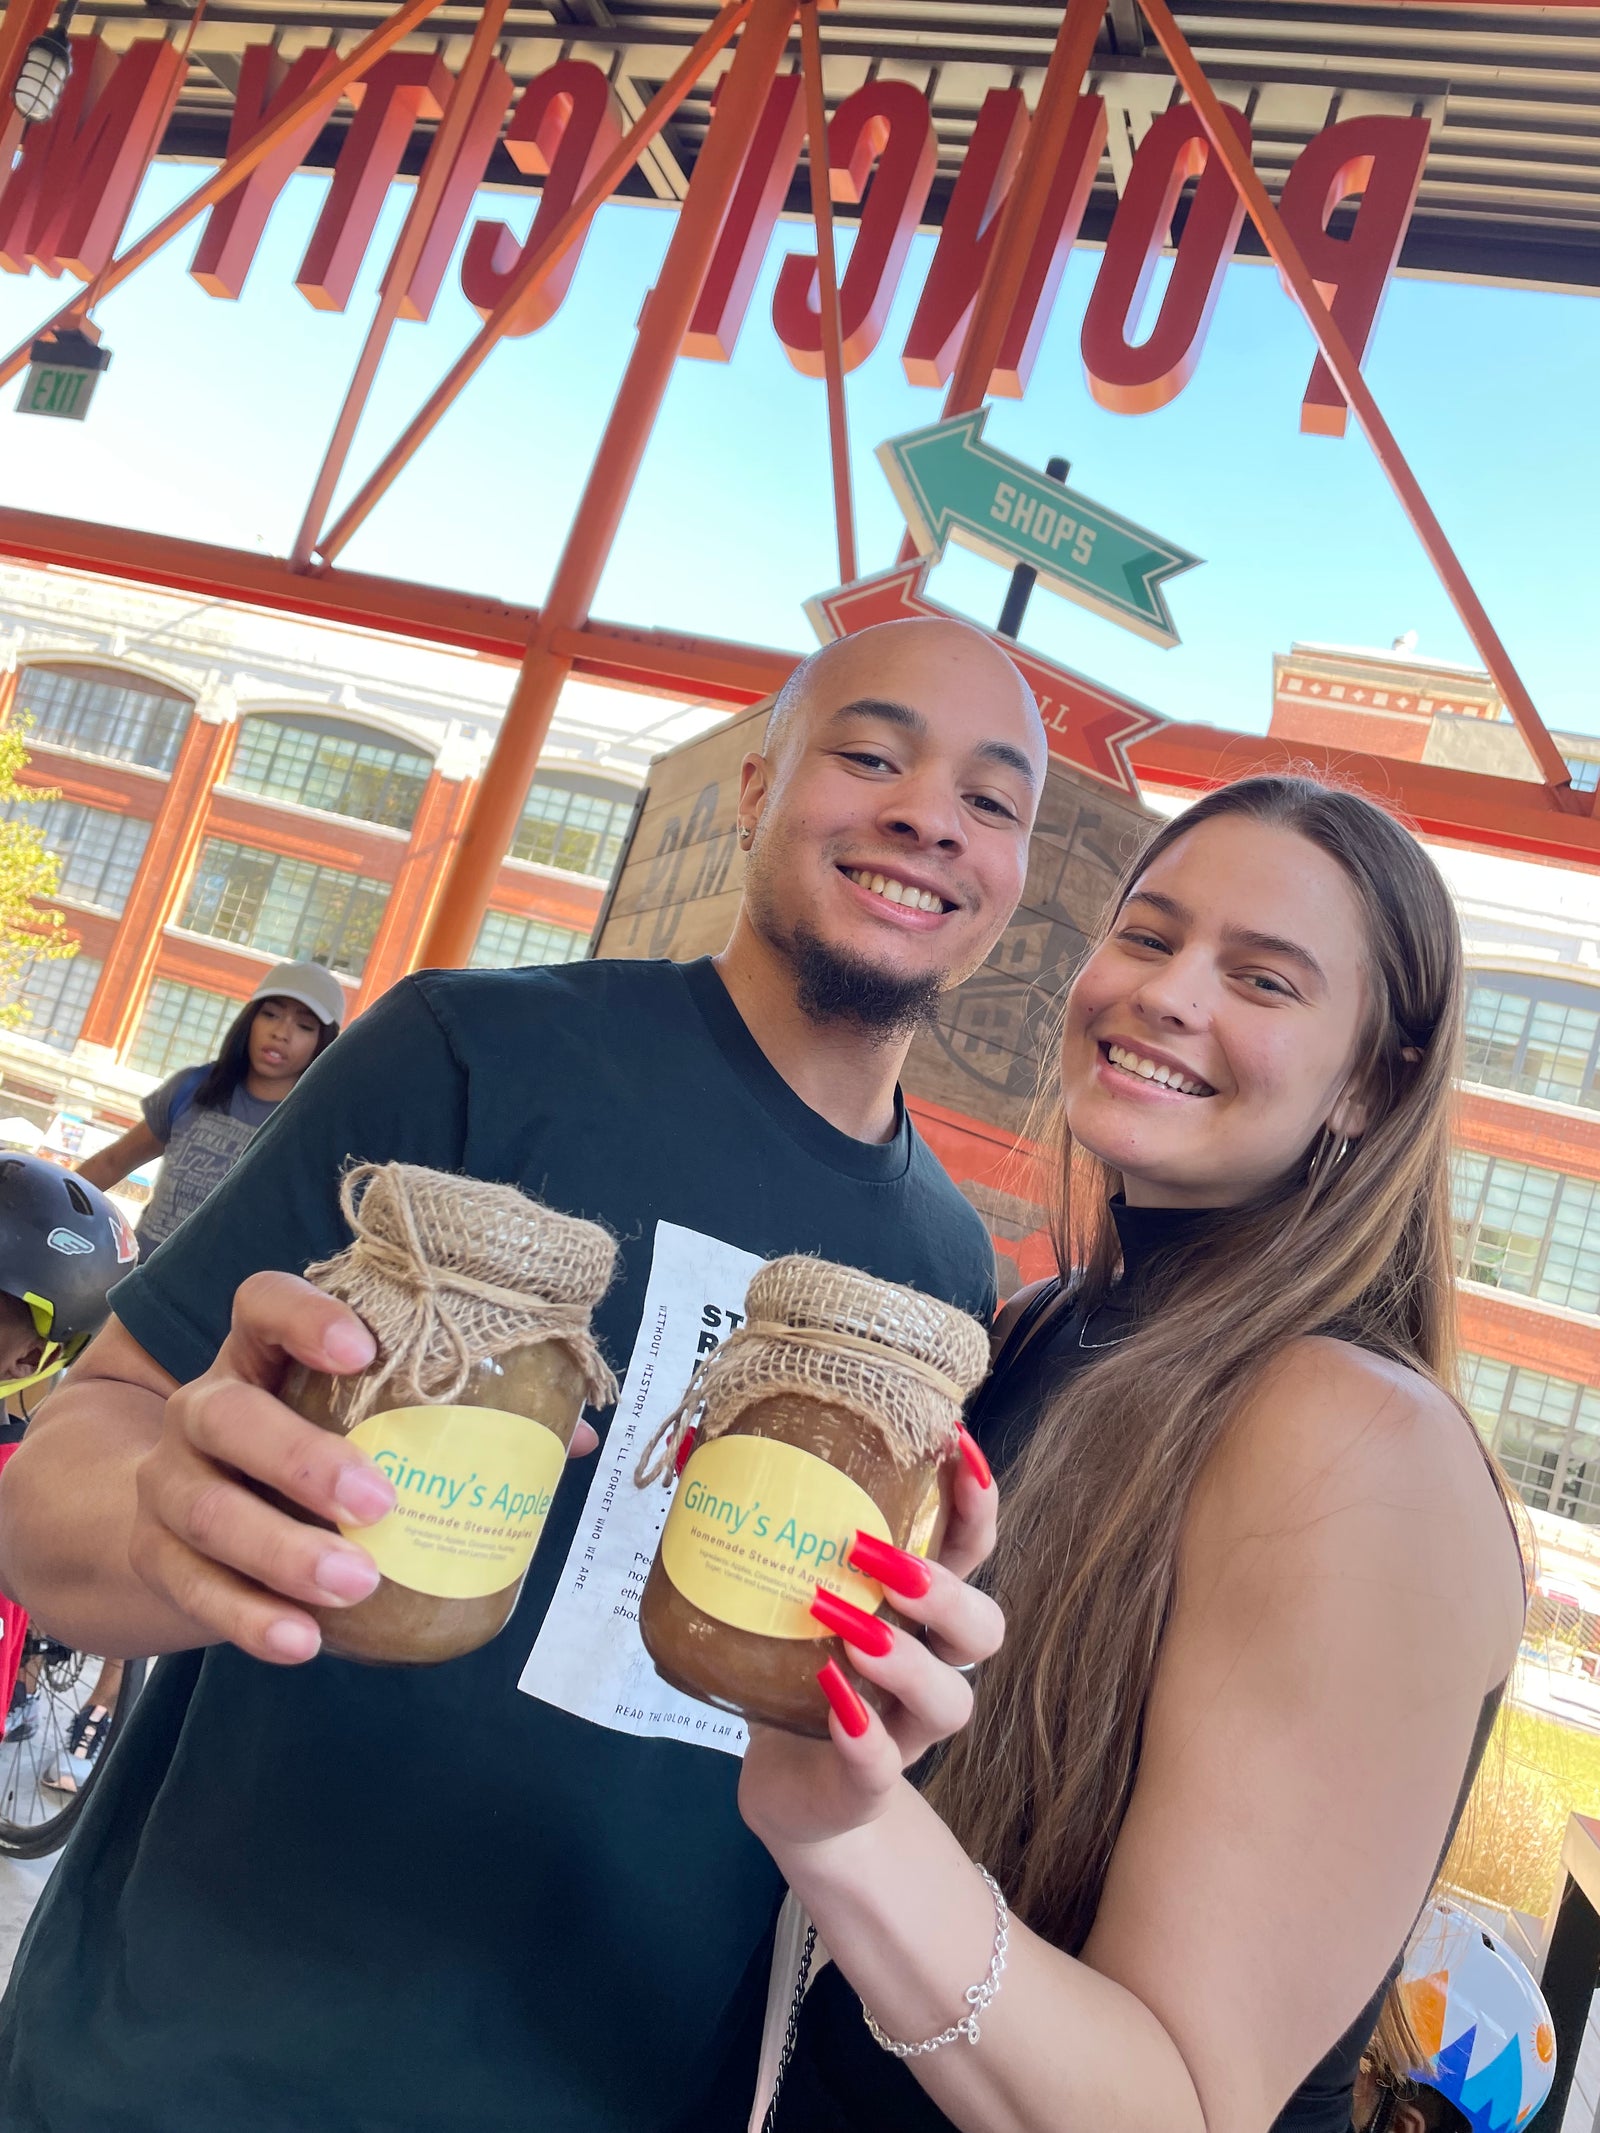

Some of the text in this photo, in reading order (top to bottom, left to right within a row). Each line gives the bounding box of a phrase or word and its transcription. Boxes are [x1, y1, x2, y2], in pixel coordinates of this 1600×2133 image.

[30, 368, 89, 413] EXIT
[989, 481, 1098, 566] SHOPS
[648, 1304, 667, 1357] WITHOUT
[631, 1363, 655, 1418] HISTORY
[616, 1424, 638, 1462] WE'LL
[600, 1467, 622, 1513] FORGET
[591, 1517, 606, 1540] WHO
[684, 1480, 871, 1578] Ginny's Appl
[583, 1545, 597, 1561] WE
[690, 1525, 842, 1593] Homemade Stewed Apples
[615, 1704, 644, 1720] READ
[695, 1719, 709, 1731] OF
[735, 1729, 743, 1740] &
